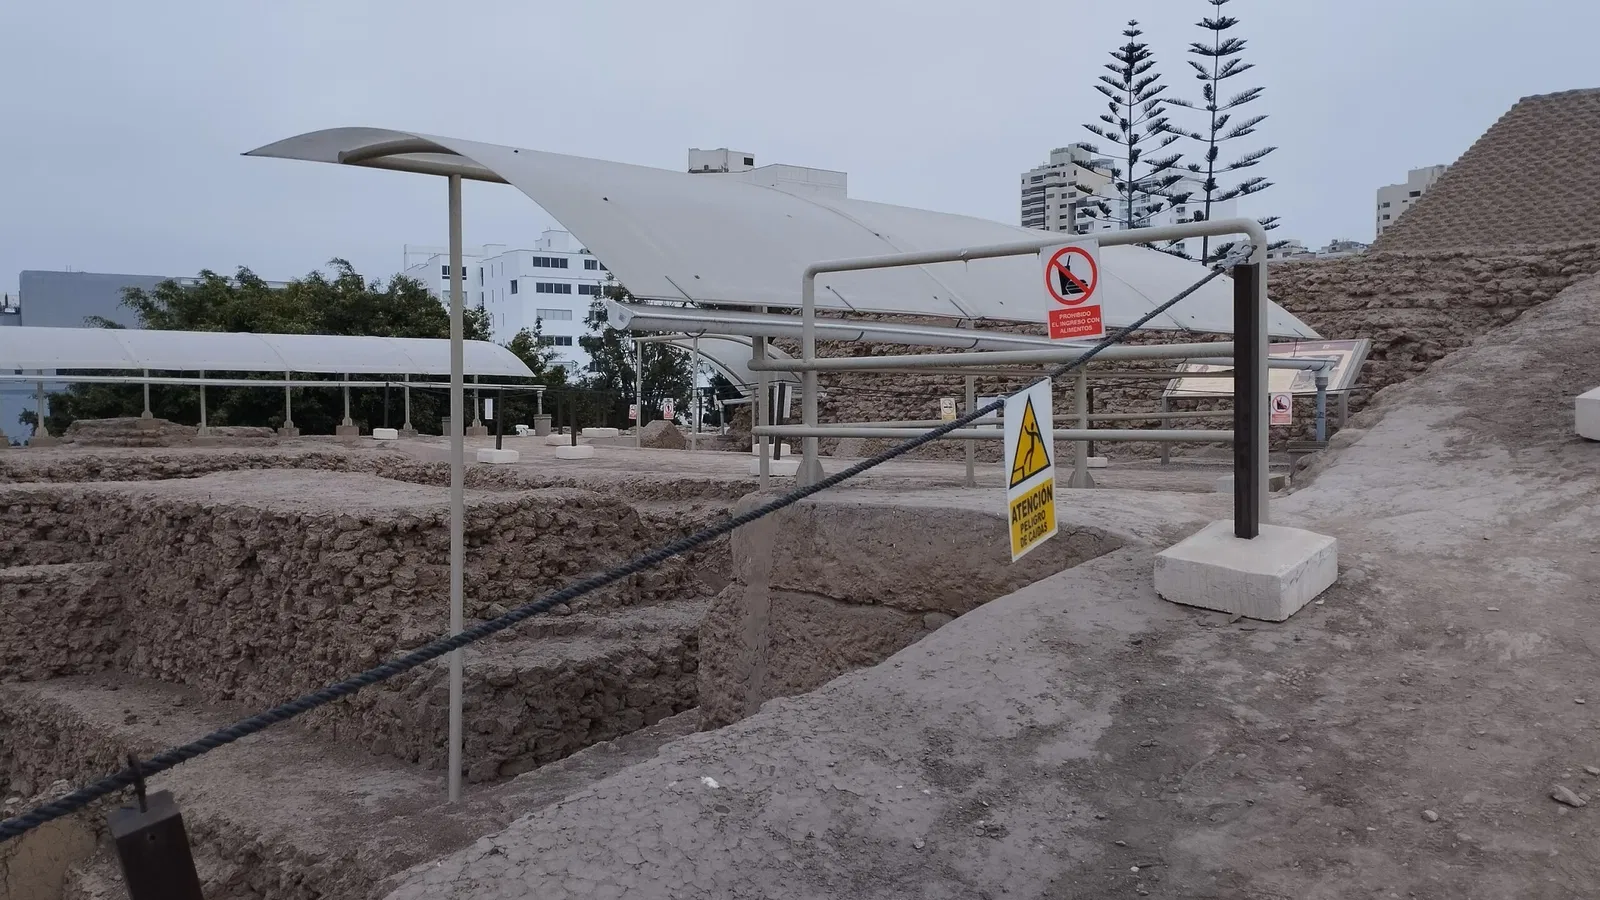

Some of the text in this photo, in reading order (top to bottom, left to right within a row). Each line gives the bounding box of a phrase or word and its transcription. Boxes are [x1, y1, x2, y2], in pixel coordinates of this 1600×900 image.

[1059, 311, 1091, 319] PROHIBIDO
[1060, 319, 1086, 327] INGRESO
[1060, 325, 1092, 333] ALIMENTOS
[1012, 483, 1053, 524] ATENCIÓN
[1020, 510, 1046, 534] PELIGRO
[1020, 535, 1027, 547] DE
